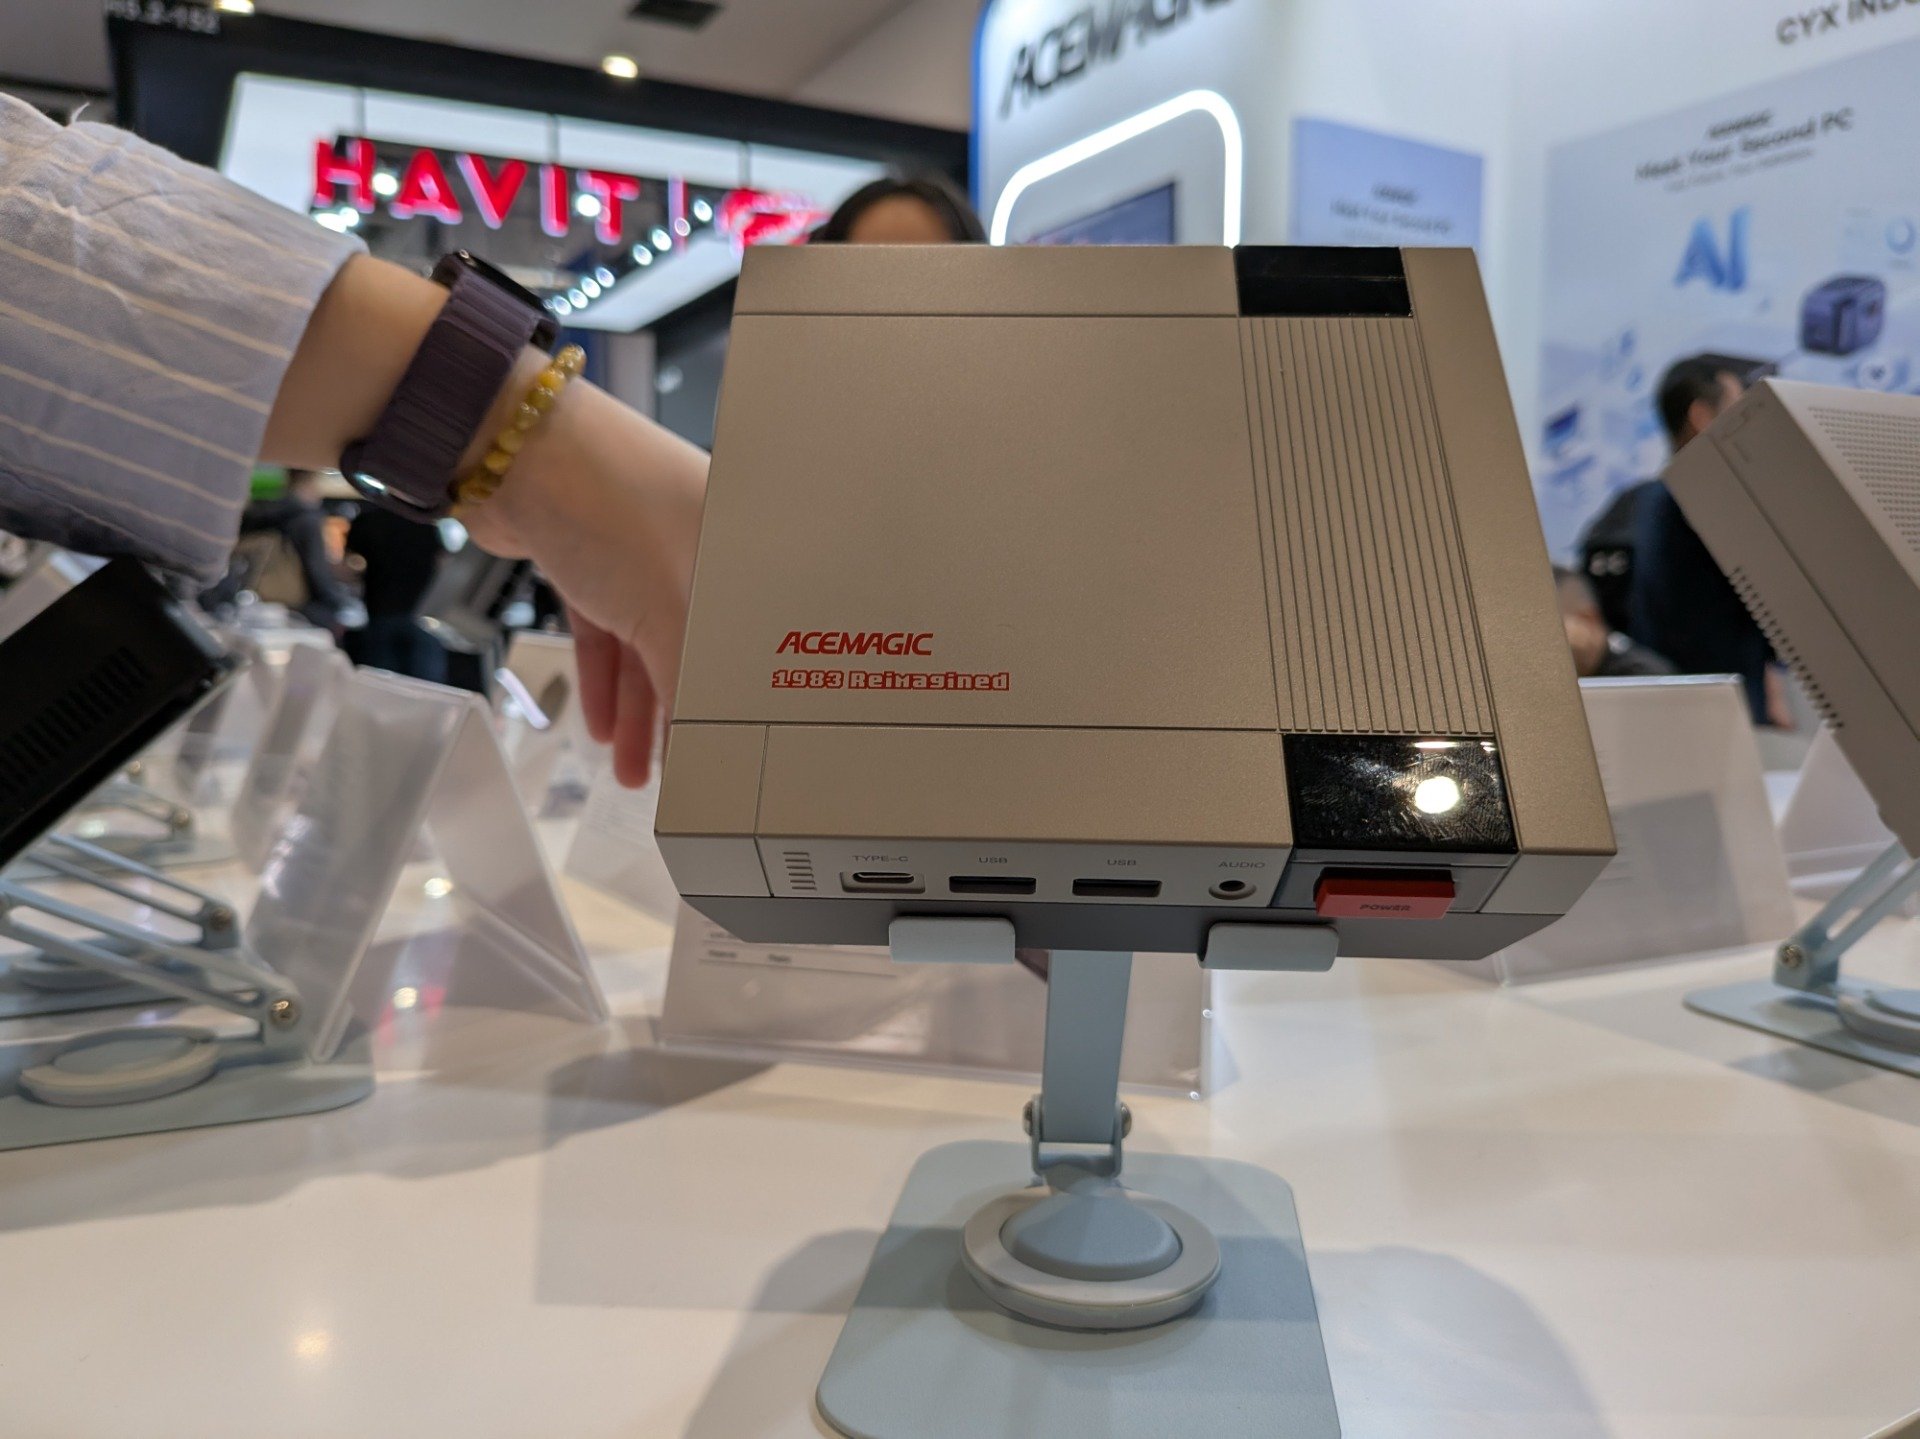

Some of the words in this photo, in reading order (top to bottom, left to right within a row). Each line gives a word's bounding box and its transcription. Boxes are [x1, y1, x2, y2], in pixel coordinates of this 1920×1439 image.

[1776, 2, 1840, 44] CYX
[312, 136, 641, 246] HAVIT
[1672, 205, 1750, 293] AI
[776, 630, 934, 656] ACEMAGIC
[771, 669, 844, 689] 1983
[848, 669, 1010, 691] Reimagined
[853, 855, 909, 863] TYPE-C
[1360, 904, 1411, 912] POWER
